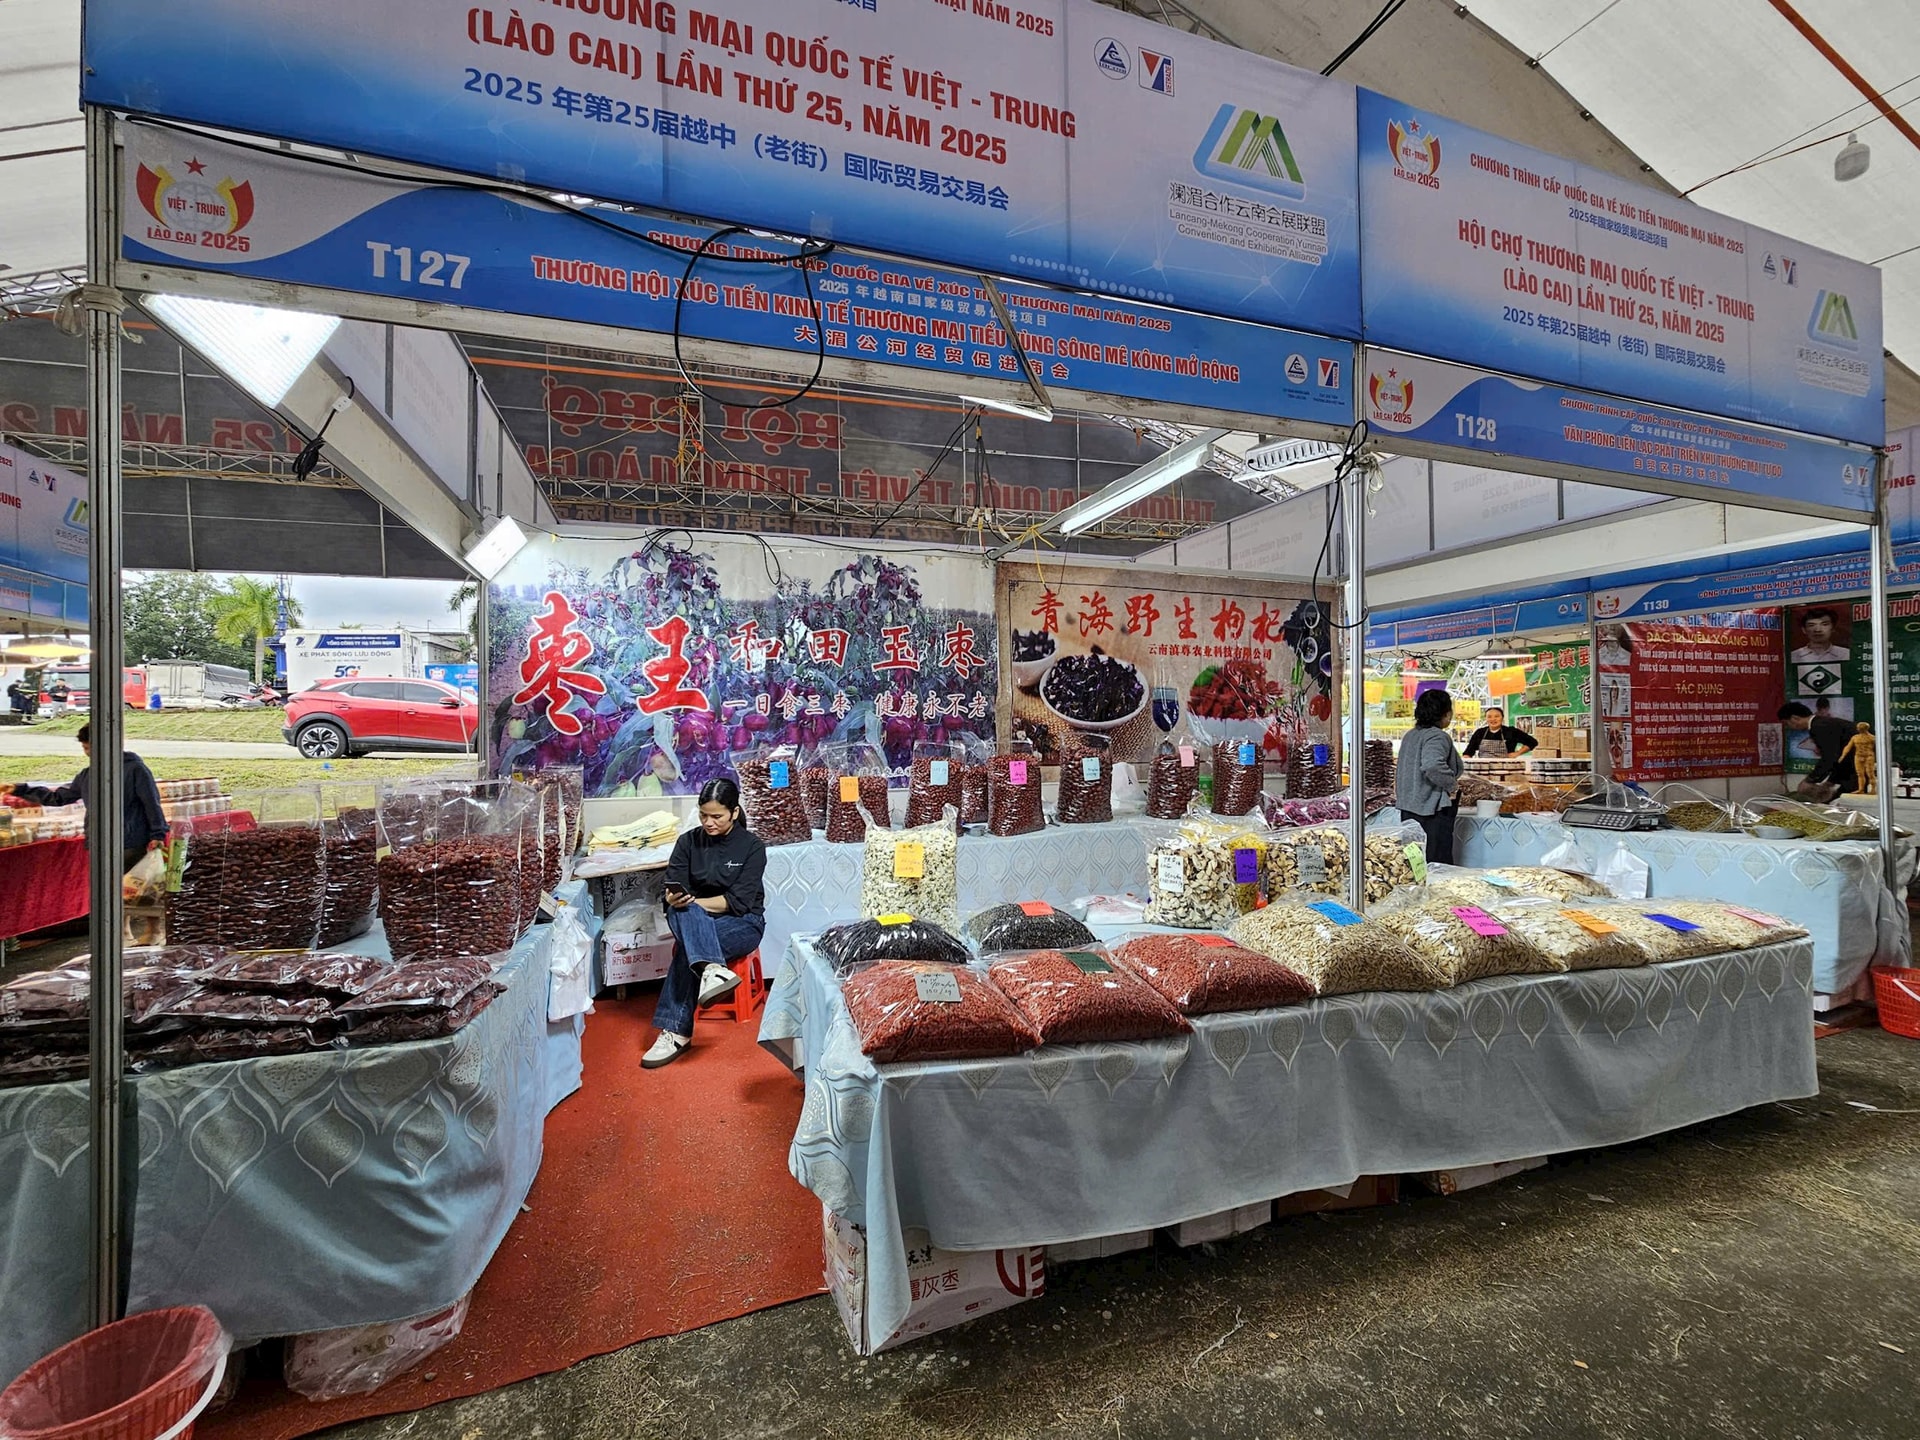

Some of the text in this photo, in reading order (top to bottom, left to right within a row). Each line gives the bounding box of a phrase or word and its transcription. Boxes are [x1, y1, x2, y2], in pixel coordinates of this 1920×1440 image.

[1015, 11, 1054, 37] 2025
[463, 68, 543, 105] 2025
[467, 8, 1007, 165] (LÀO CAI) LẦN THỨ 25, NĂM 2025
[689, 10, 753, 57] MẠI
[765, 32, 849, 79] QUỐC
[859, 54, 894, 91] TẾ
[902, 67, 962, 110] VIỆT
[989, 91, 1076, 138] TRUNG
[1417, 172, 1440, 190] 2025
[168, 196, 226, 218] VIỆT TRUNG
[1169, 181, 1326, 236] 澜湄合作云南会展联盟
[1470, 153, 1744, 255] CHƯƠNG TRÌNH CẤP QUỐC GIA VỀ XÚC TIẾN THƯƠNG MẠI NĂM 2025
[147, 226, 250, 253] LÀO CAI 2025
[1169, 209, 1328, 254] Lancang-Mekong Cooperation Yunnan
[1178, 223, 1321, 265] Convention and Exhibition Alliance
[366, 240, 471, 290] T127
[1458, 218, 1755, 322] HỘI CHỢ THƯƠNG MẠI QUỐC TẾ VIỆT TRUNG
[818, 278, 849, 295] 2025
[832, 264, 878, 281] QUỐC
[882, 273, 911, 288] GIA
[914, 274, 935, 290] VỀ
[937, 279, 970, 297] XÚC
[1010, 294, 1070, 314] THƯƠNG
[1072, 304, 1101, 320] MẠI
[1104, 308, 1136, 326] NĂM
[1138, 316, 1172, 333] 2025
[1503, 268, 1725, 344] (LÀO CAI) LẦN THỨ 25, NĂM 2025
[531, 255, 1240, 384] THƯƠNG HỘI XÚC TIẾN KINH TẾ THƯƠNG MẠI TIỂU SÔNG MÊ KÔNG MỞ RỘNG
[1503, 305, 1534, 327] 2025
[1393, 412, 1412, 424] 2025
[1456, 412, 1497, 442] T128
[1560, 398, 1594, 413] CHƯƠNG
[1596, 404, 1619, 417] TRÌNH
[1620, 408, 1637, 420] CẤP
[1585, 428, 1615, 449] PHÒNG
[1618, 433, 1636, 451] LIÊN
[1637, 439, 1653, 458] LẠC
[1655, 440, 1675, 458] PHÁT
[1677, 443, 1699, 463] TRIỂN
[1701, 450, 1716, 465] KHU
[1717, 453, 1751, 472] THƯƠNG
[1031, 589, 1286, 645] 青海野生枸杞
[1643, 599, 1669, 611] T130
[370, 650, 391, 658] ĐỘNG
[729, 619, 986, 679] 和田玉枣
[1676, 680, 1724, 697] TÁC DỤNG
